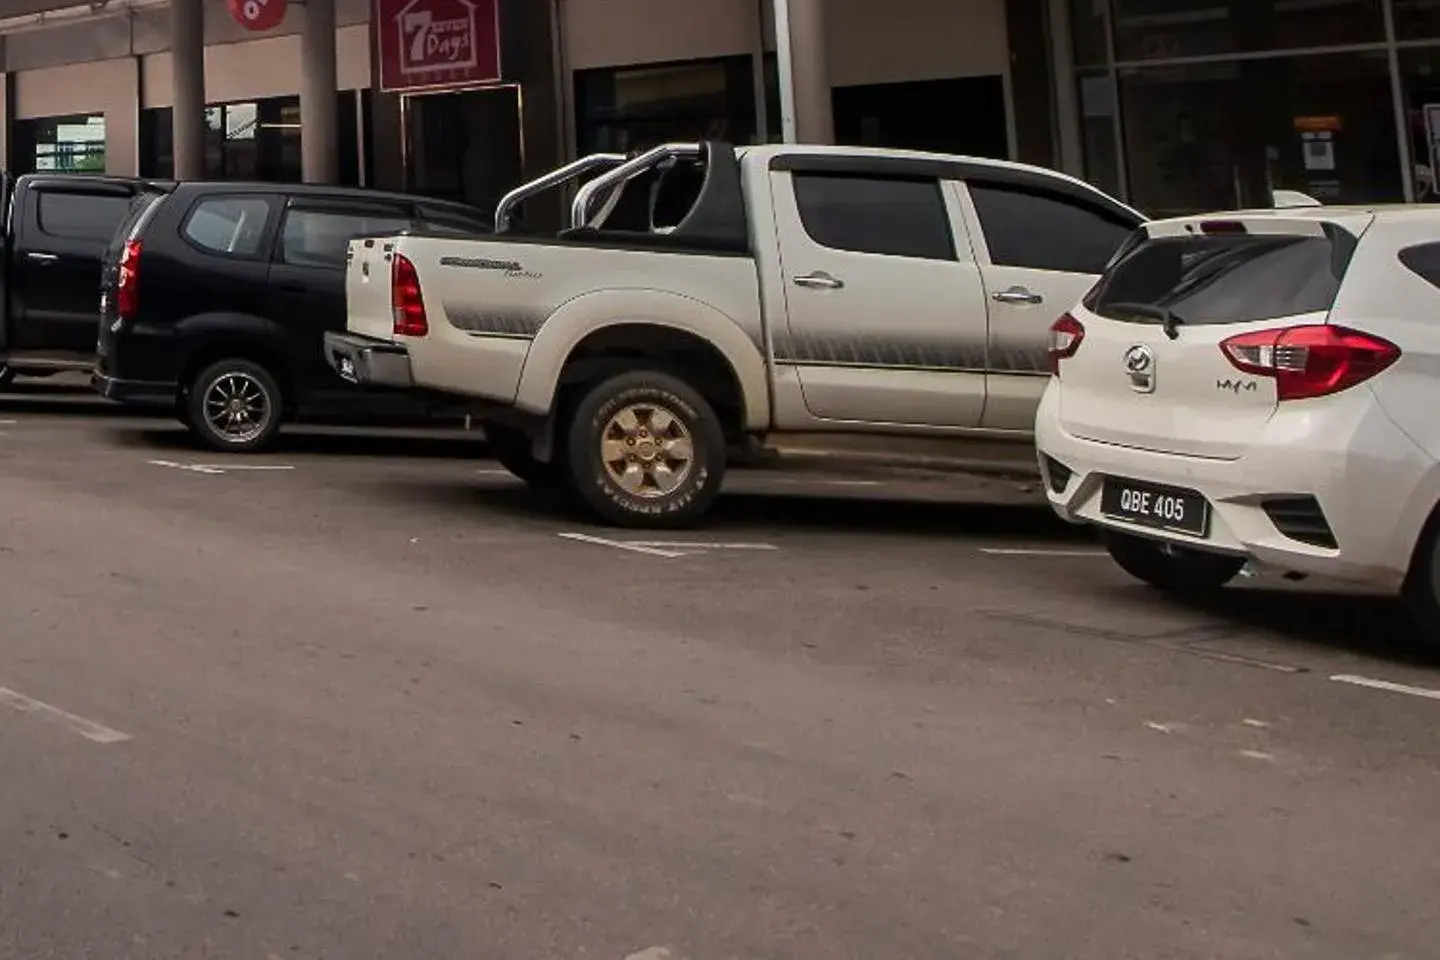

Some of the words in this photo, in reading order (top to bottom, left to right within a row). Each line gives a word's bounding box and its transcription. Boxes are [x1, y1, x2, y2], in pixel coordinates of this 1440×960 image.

[404, 10, 432, 61] 7
[427, 32, 469, 60] Days
[1120, 489, 1152, 515] QBE
[1154, 495, 1185, 521] 405
